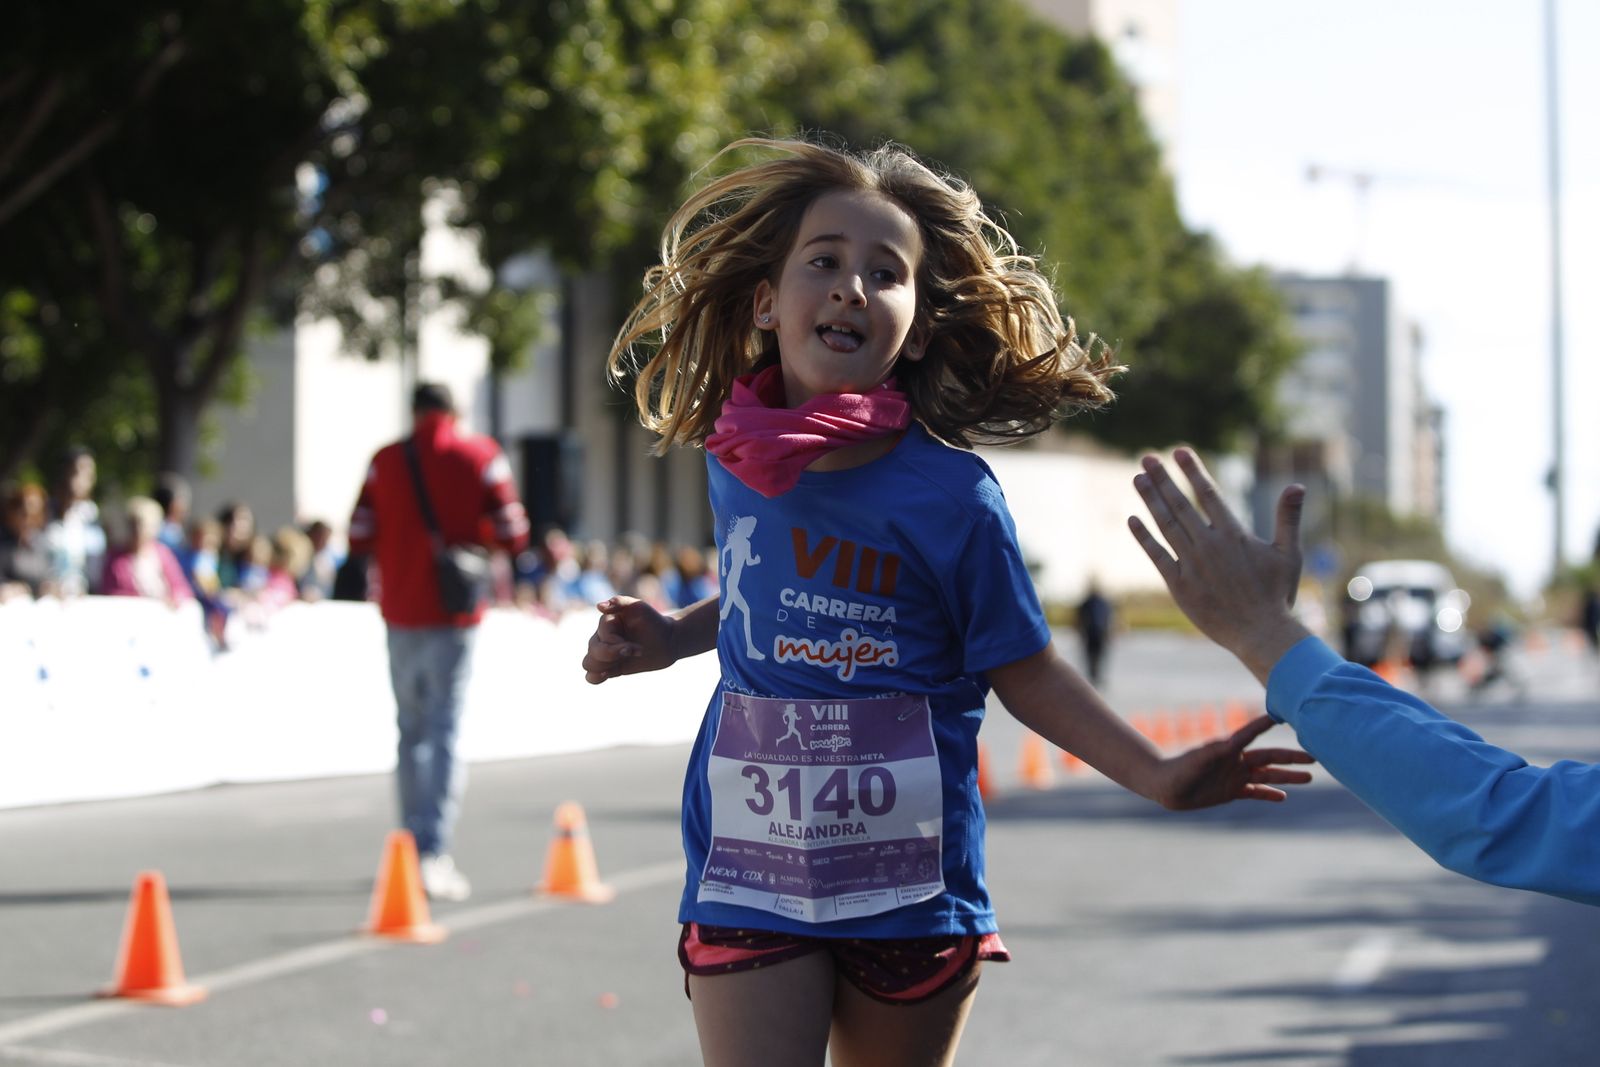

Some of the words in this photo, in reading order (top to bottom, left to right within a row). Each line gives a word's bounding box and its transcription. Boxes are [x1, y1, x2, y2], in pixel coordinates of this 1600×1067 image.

[791, 527, 900, 596] VIII
[780, 588, 897, 622] CARRERA
[810, 704, 849, 721] VIII
[744, 751, 753, 760] LA
[754, 752, 799, 762] IGUALDAD
[801, 755, 813, 763] ES
[815, 755, 859, 763] NUESTRA
[860, 752, 885, 761] META
[741, 764, 897, 821] 3140
[768, 821, 867, 840] ALEJANDRA
[707, 865, 738, 879] NEXA
[742, 869, 766, 882] CDX
